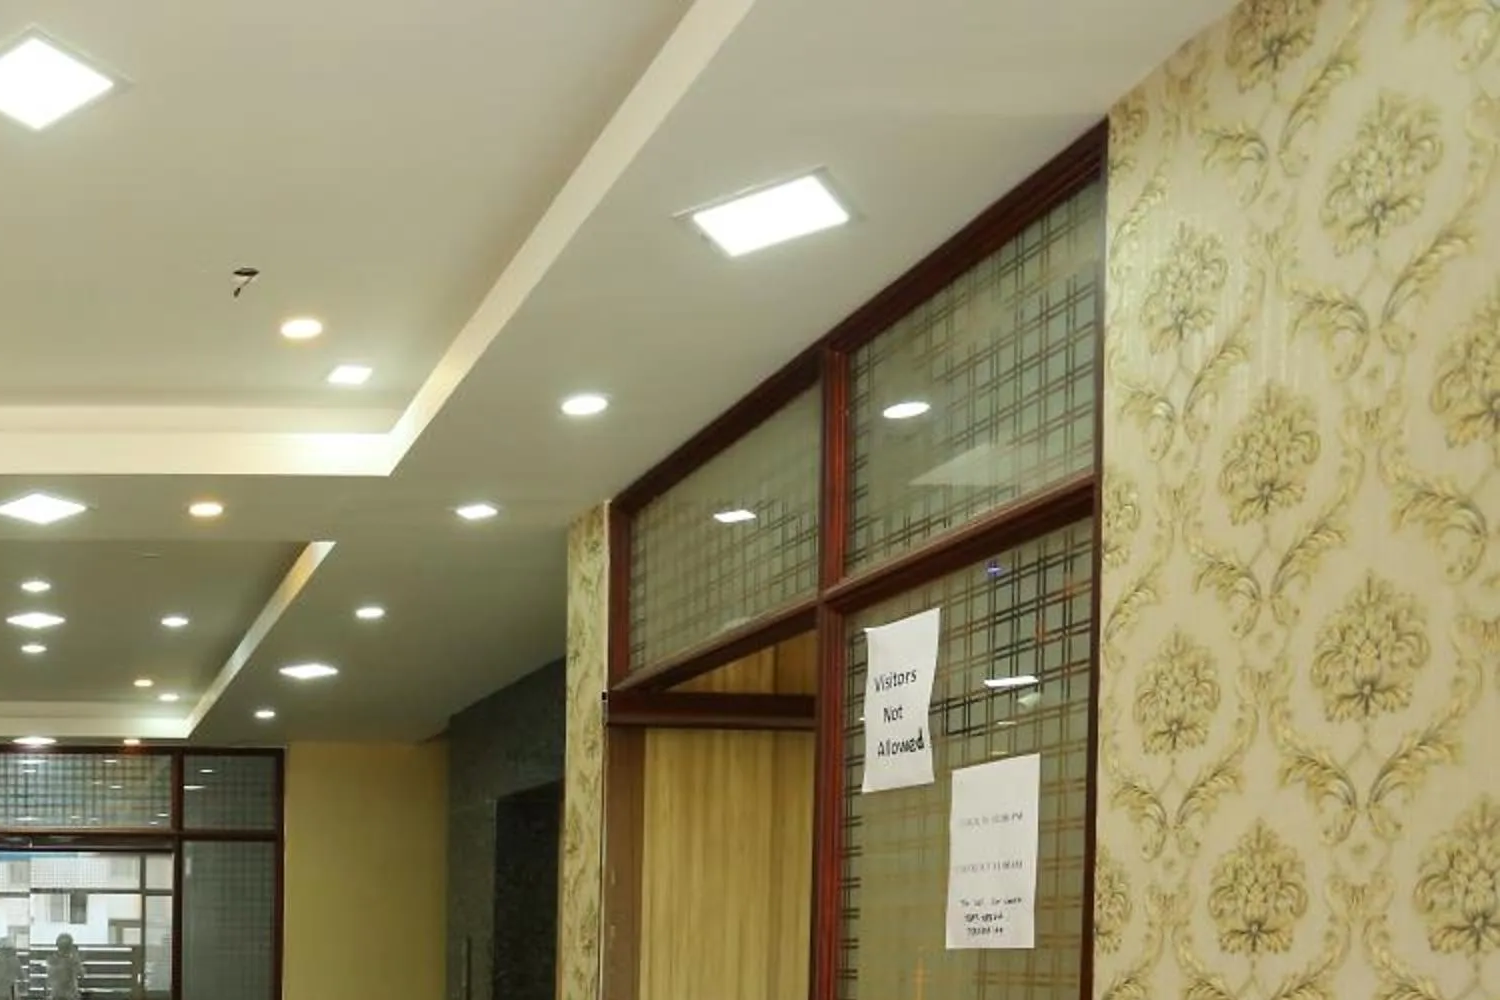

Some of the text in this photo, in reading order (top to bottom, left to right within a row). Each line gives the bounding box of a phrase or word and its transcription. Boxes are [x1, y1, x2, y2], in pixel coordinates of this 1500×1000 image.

[873, 669, 917, 692] Visitors
[883, 705, 903, 723] Not
[877, 727, 925, 757] Allowed
